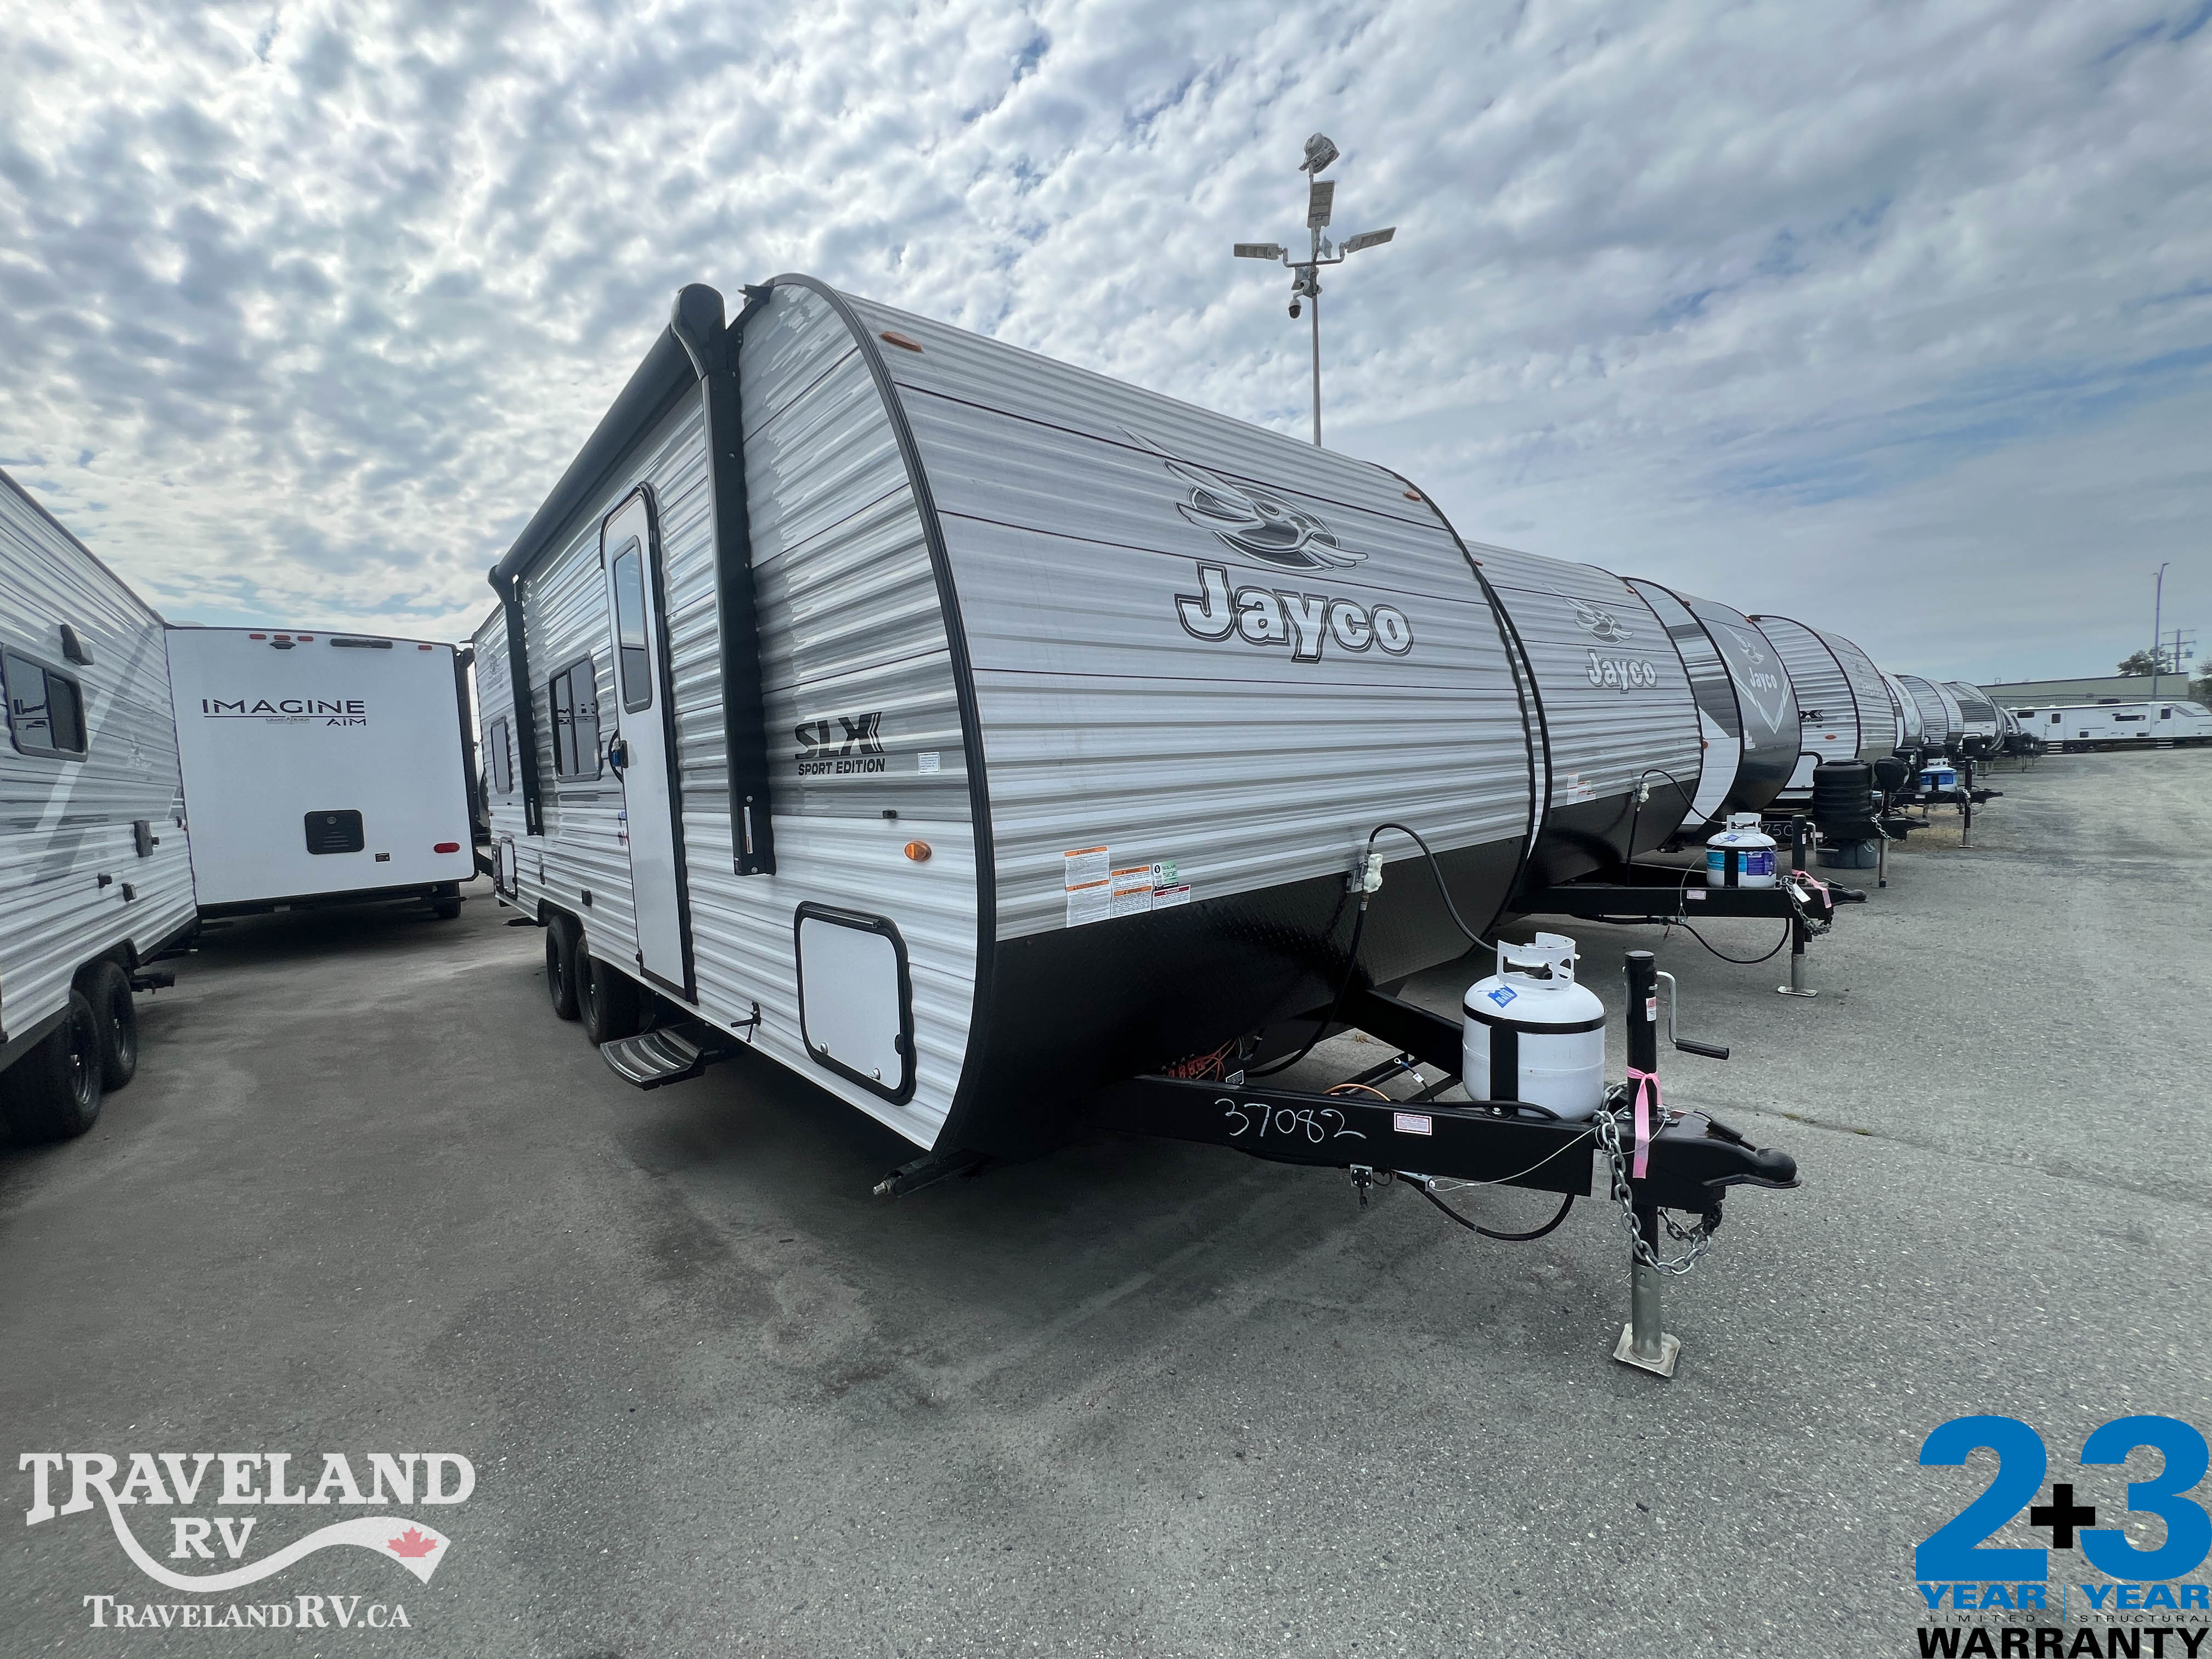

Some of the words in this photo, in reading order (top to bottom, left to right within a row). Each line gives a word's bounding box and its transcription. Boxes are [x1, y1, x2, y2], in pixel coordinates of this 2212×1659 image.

[1175, 561, 1414, 664] Jayco
[1585, 649, 1657, 694] Jayco
[1748, 667, 1778, 692] Jayco
[202, 698, 365, 714] IMAGINE
[795, 711, 884, 759] SLX
[798, 761, 833, 776] SPORT
[836, 758, 885, 774] EDITION
[1215, 1098, 1367, 1143] 37082
